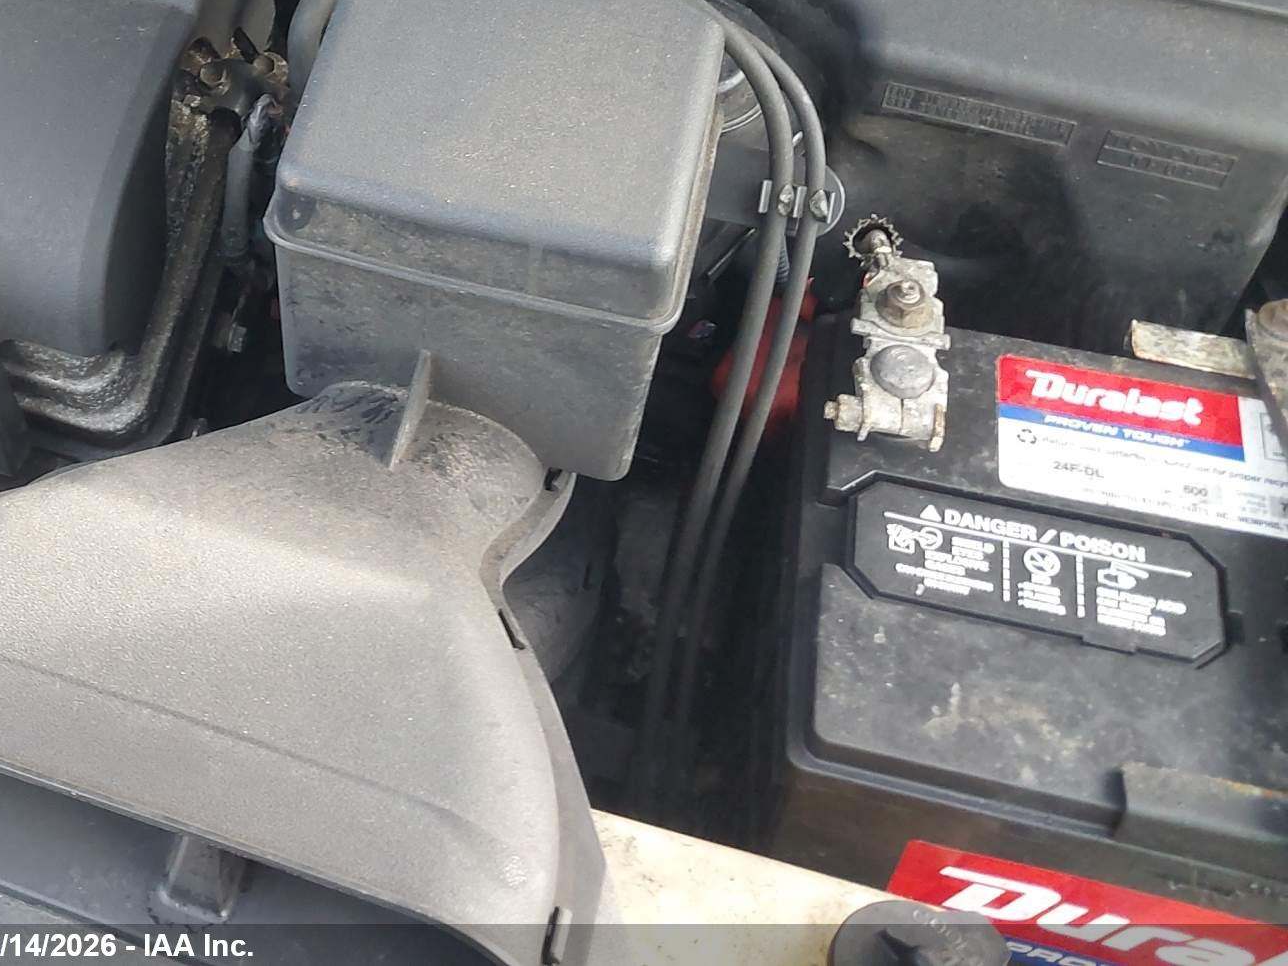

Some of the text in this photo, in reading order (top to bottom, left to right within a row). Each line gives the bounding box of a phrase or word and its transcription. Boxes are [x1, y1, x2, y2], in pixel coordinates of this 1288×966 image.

[1025, 369, 1204, 426] Duralast
[1044, 414, 1119, 436] PROVEN
[1053, 460, 1105, 479] 24F-DL
[943, 508, 1038, 542] DANGER
[1059, 532, 1146, 563] POISON
[939, 866, 1288, 966] Dura
